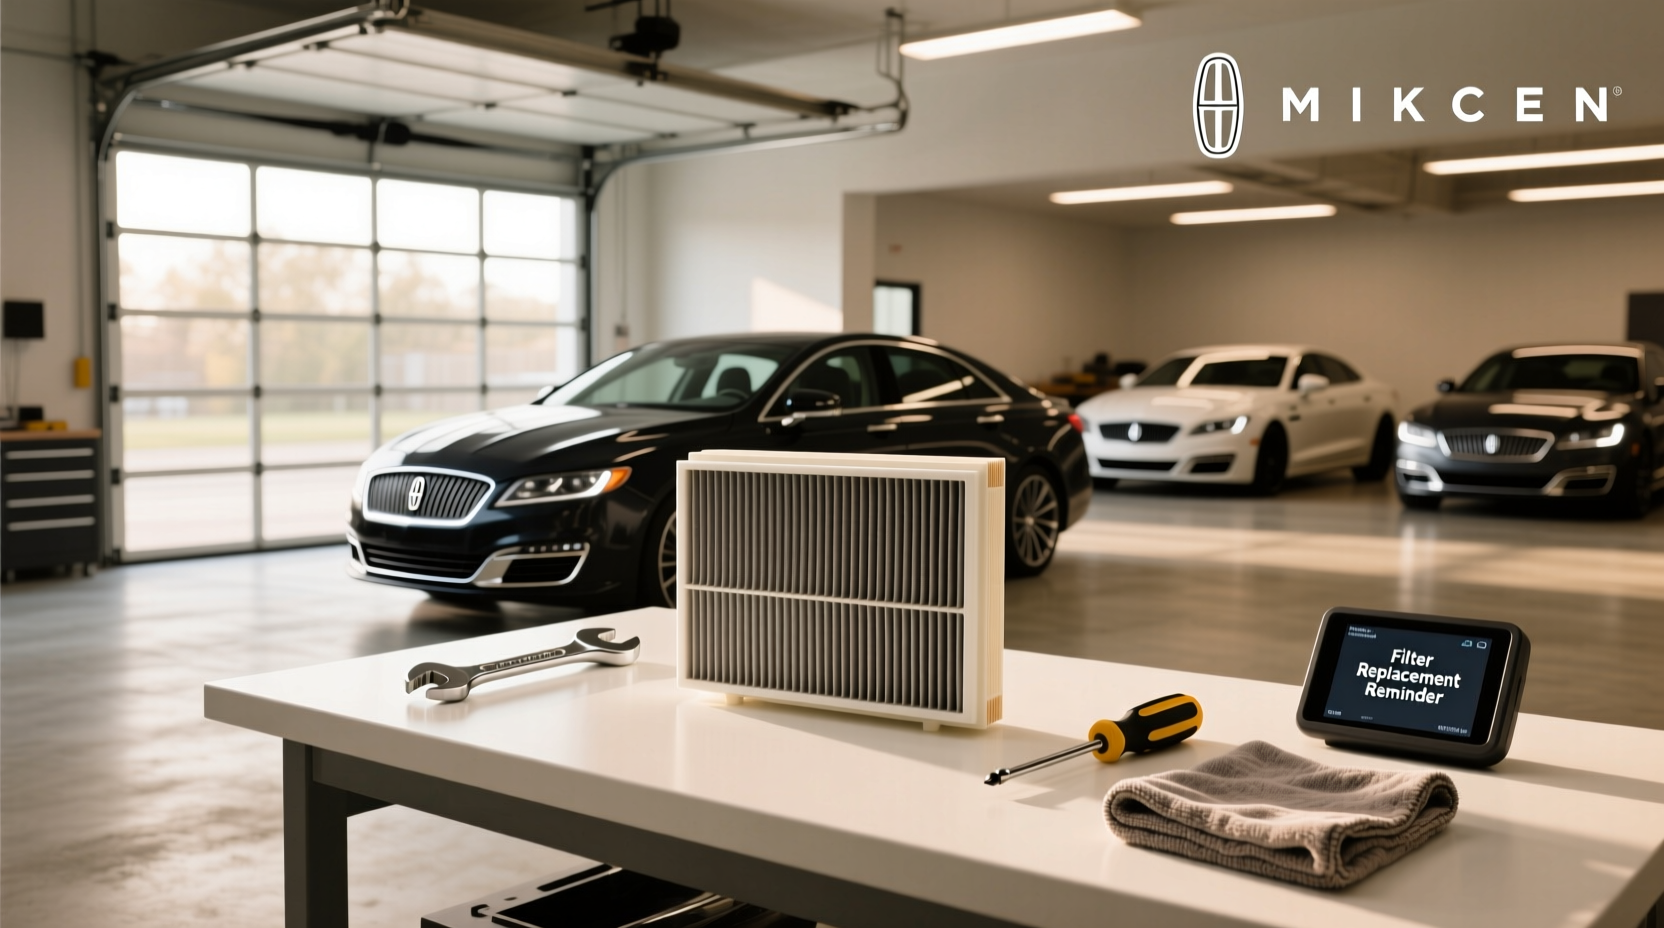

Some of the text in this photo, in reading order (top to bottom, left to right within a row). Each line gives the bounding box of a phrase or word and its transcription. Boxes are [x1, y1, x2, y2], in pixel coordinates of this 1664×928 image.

[1390, 648, 1434, 667] Filter
[1356, 662, 1461, 688] Replacement
[1364, 682, 1444, 704] Reminder
